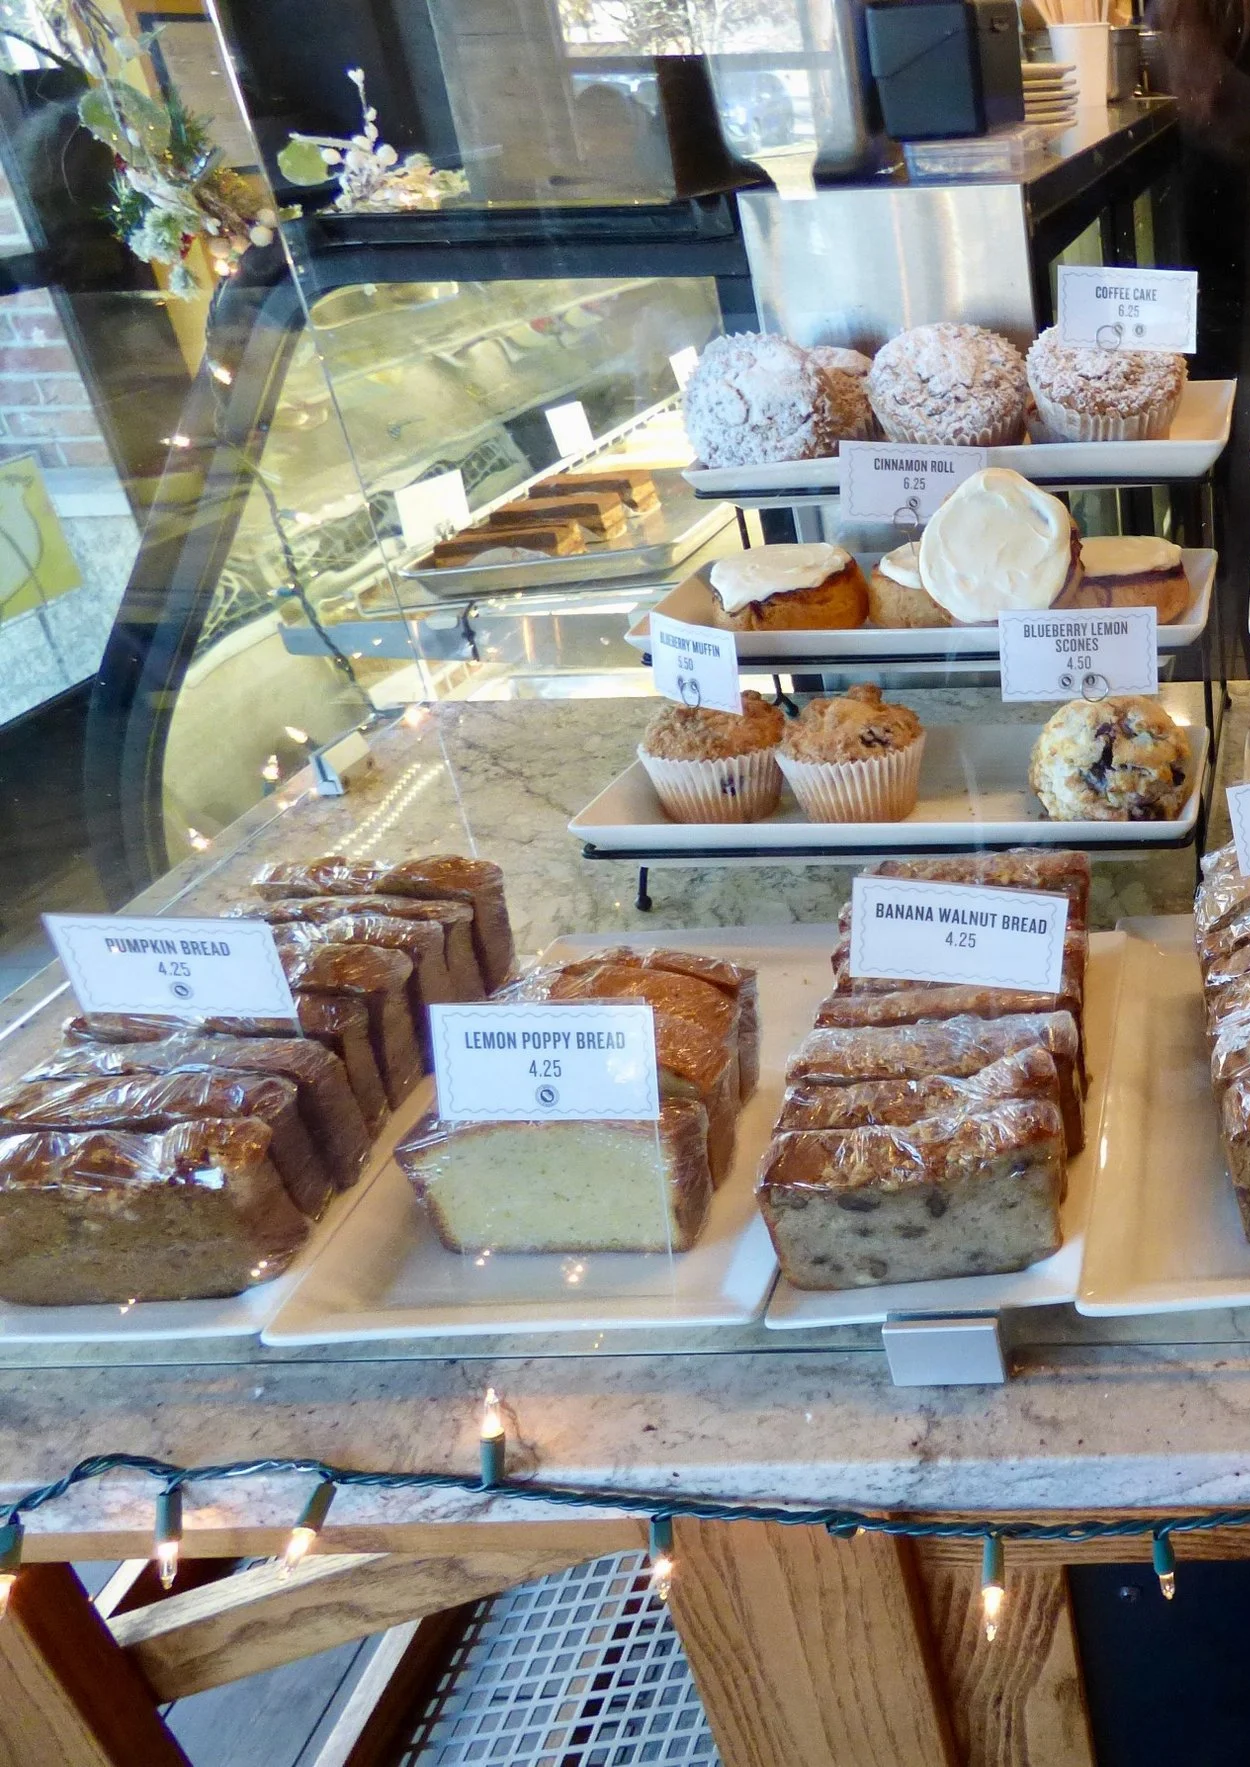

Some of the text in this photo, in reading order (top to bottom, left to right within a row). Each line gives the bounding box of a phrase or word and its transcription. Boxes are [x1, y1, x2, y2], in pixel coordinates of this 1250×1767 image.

[1095, 286, 1158, 301] COFFEE CAKE
[1118, 304, 1140, 318] 6.25
[874, 457, 955, 474] CINNAMON ROLL
[903, 477, 926, 490] 6.25
[1023, 621, 1128, 638] BLUEBERRY LEMON
[691, 640, 721, 658] MUFFIN
[1055, 637, 1099, 653] SCONES
[677, 655, 694, 671] 5.50
[1066, 655, 1092, 670] 4.50
[875, 902, 1048, 935] BANANA WALNUT BREAD
[104, 937, 231, 957] PUMPKIN BREAD
[945, 931, 977, 948] 4.25
[158, 961, 191, 977] 4.25
[464, 1031, 626, 1050] LEMON POPPY BREAD
[528, 1059, 562, 1078] 4.25
